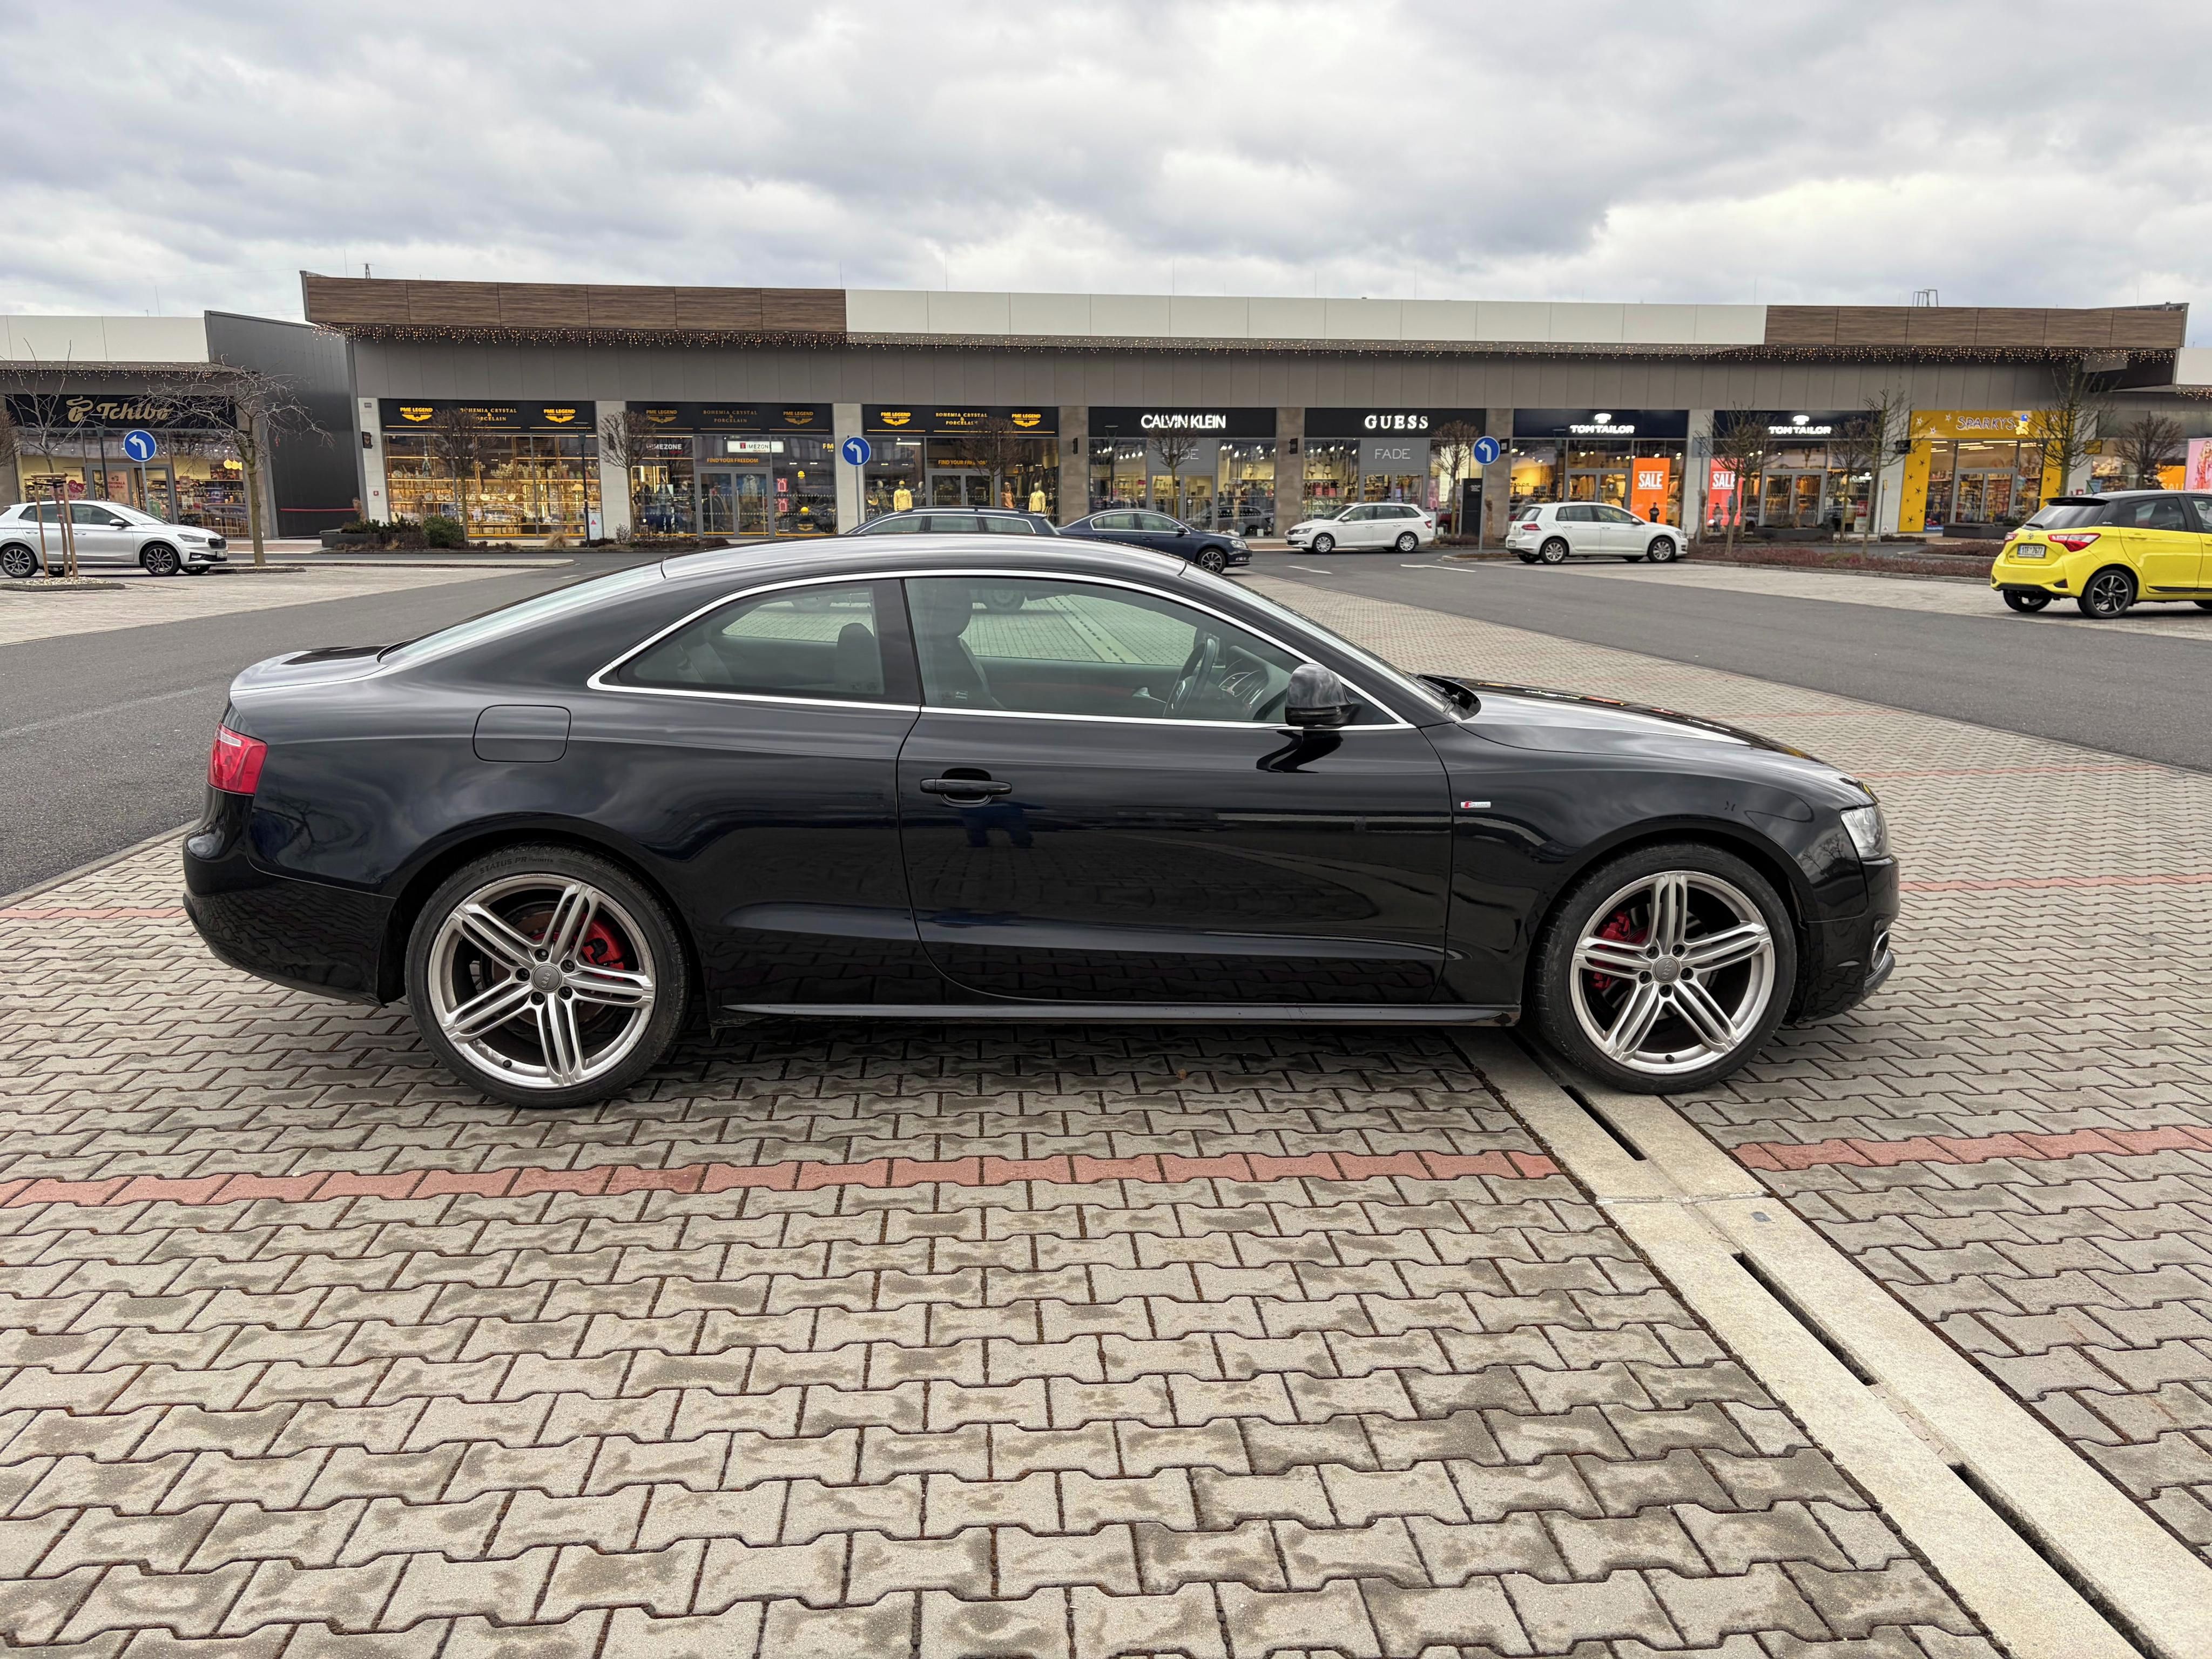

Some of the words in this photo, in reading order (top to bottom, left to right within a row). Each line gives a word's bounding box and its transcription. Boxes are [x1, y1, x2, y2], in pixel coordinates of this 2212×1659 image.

[96, 402, 174, 420] Tchibo
[1141, 414, 1188, 428] CALVIN
[1190, 414, 1226, 428] KLEIN
[1364, 415, 1428, 429] GUESS
[1956, 416, 2015, 430] SPARKYS
[1569, 425, 1595, 434] TOM
[1595, 425, 1635, 434] TAILOR
[1768, 426, 1792, 434] TOM
[1793, 426, 1831, 434] TAILOR
[1374, 449, 1411, 459] FADE
[1638, 473, 1663, 488] SALE
[480, 858, 512, 874] STATUS
